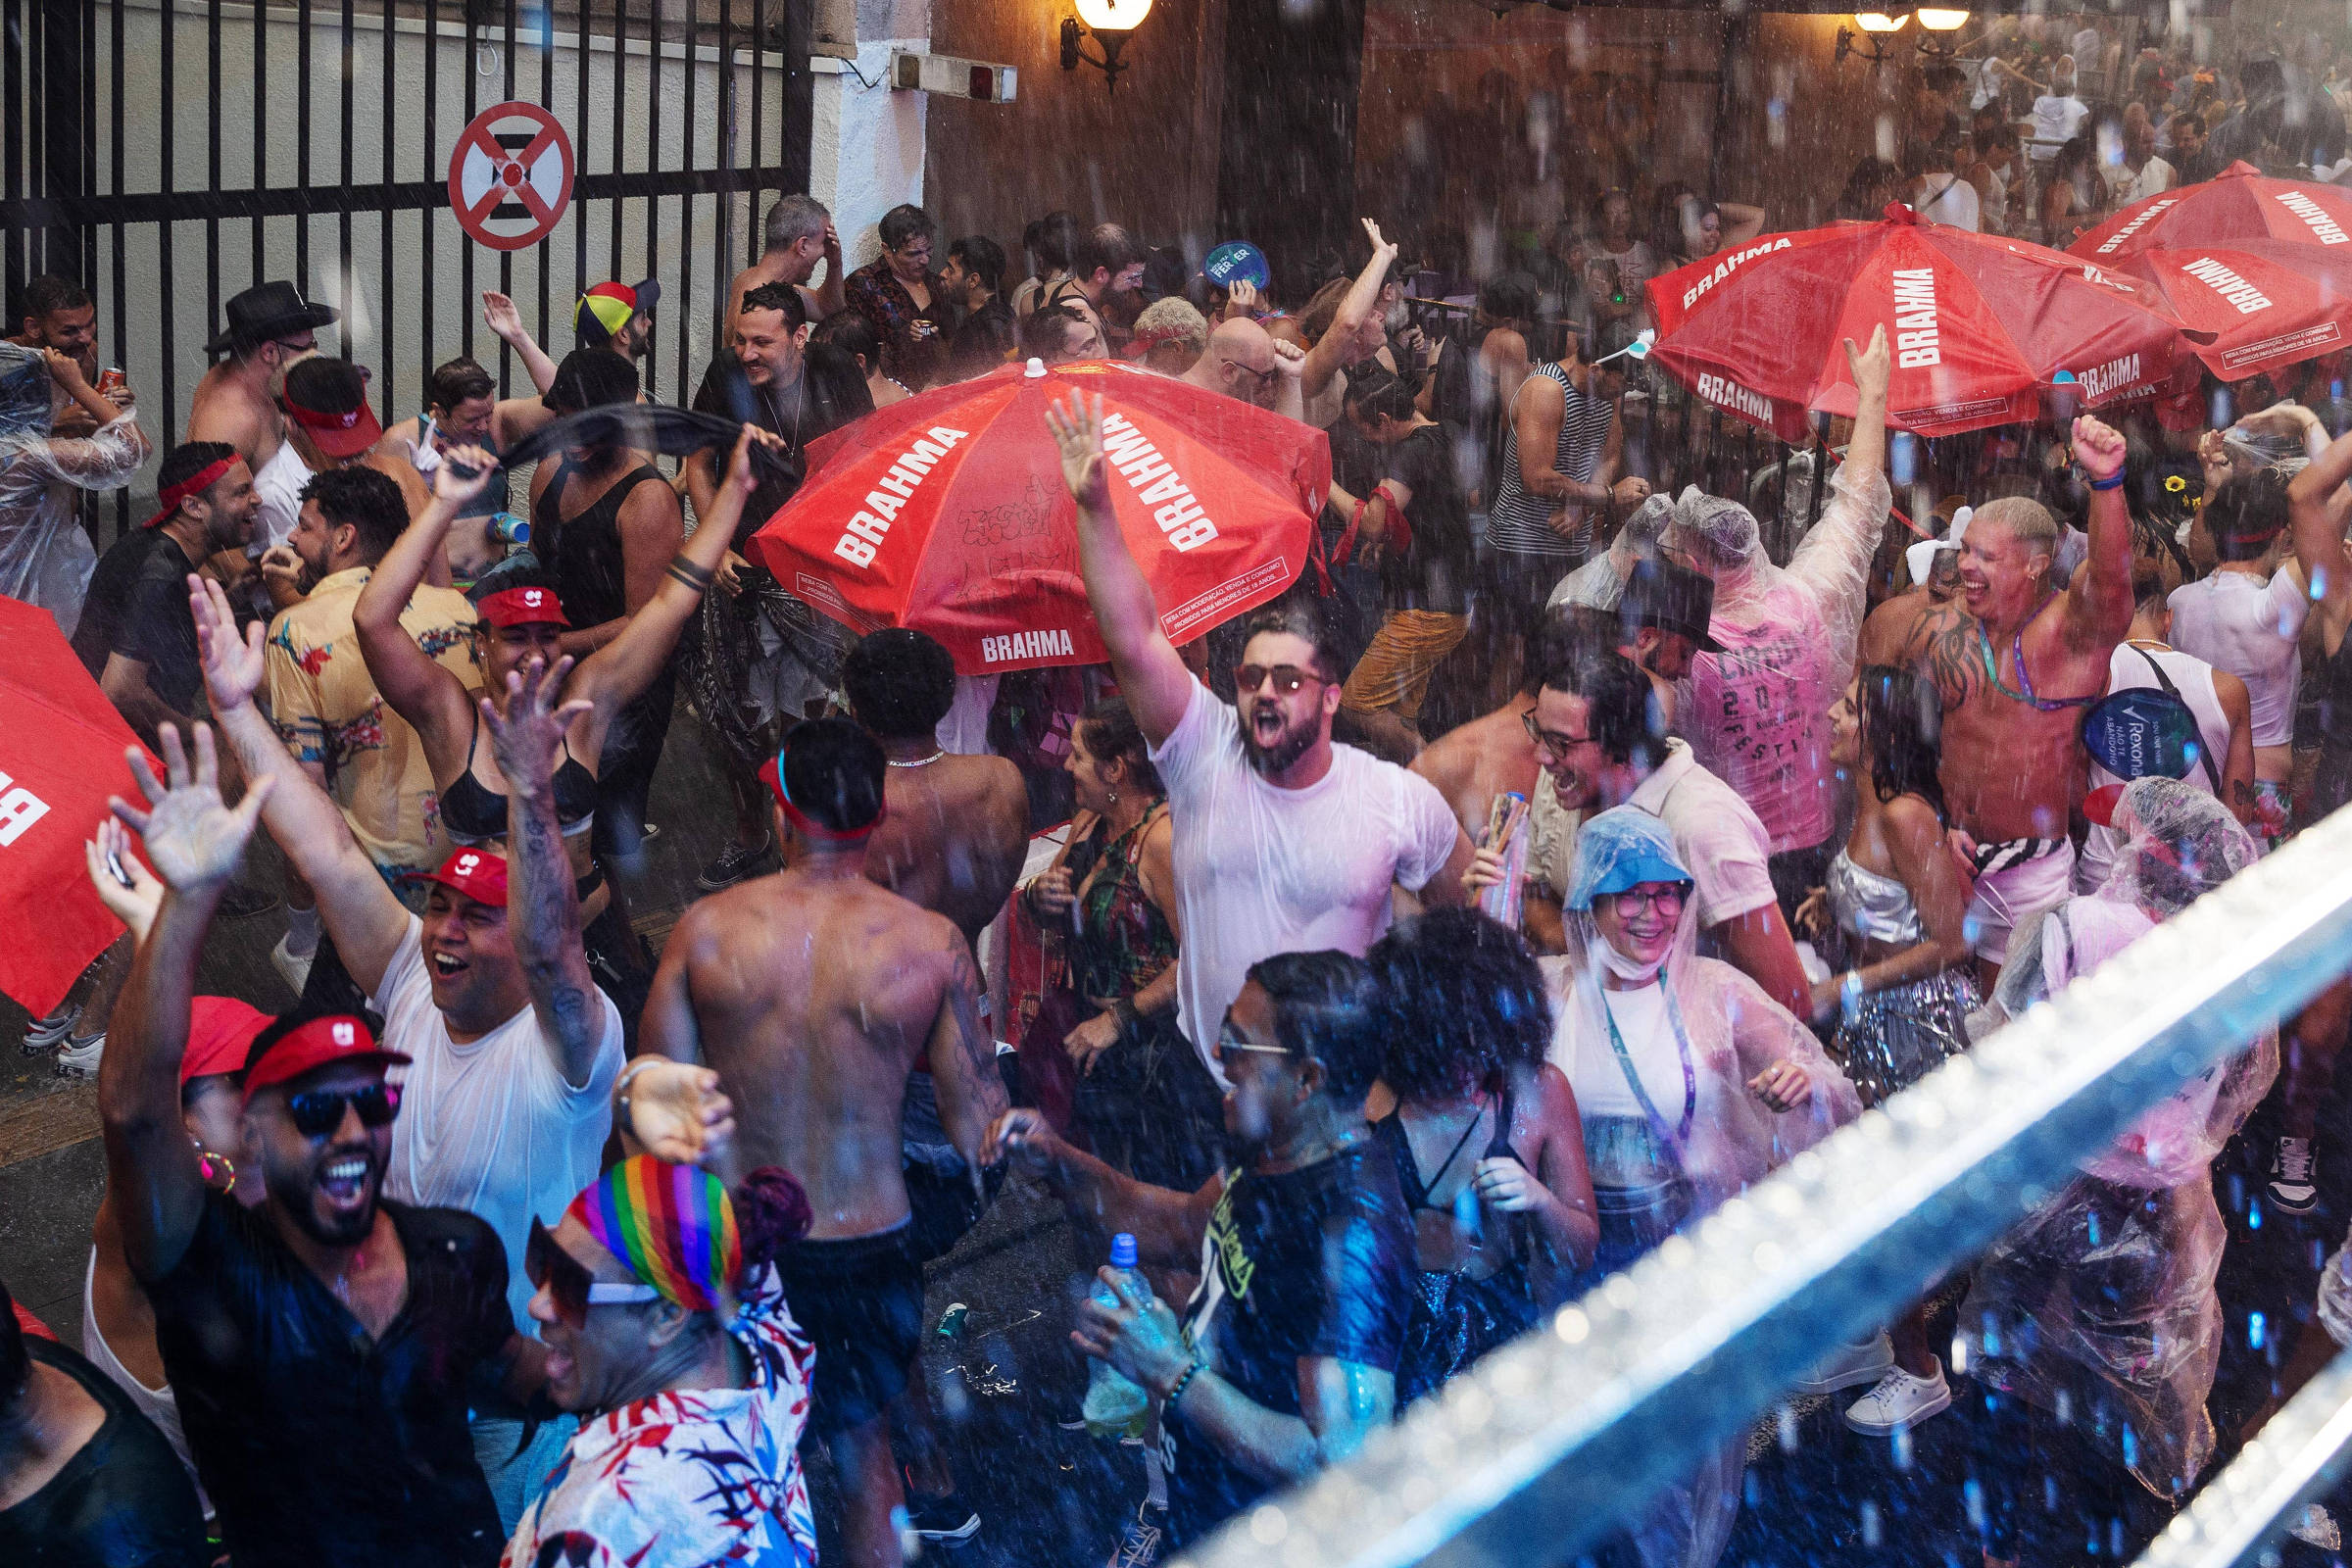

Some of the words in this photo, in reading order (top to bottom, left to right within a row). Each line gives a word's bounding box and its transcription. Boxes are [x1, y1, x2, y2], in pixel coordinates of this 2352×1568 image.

[2096, 198, 2180, 253] BRAHMA
[2275, 191, 2350, 244] BRAHMA
[1683, 237, 1791, 310] BRAHMA
[2180, 257, 2273, 314] BRAHMA
[1892, 268, 1940, 368] BRAHMA
[1697, 372, 1773, 424] BRAHMA
[834, 426, 969, 568] BRAHMA
[1102, 413, 1219, 553] BRAHMA
[1178, 606, 1192, 617] COM
[1225, 578, 1246, 593] VENDA
[1250, 561, 1281, 581] CONSUMO
[1200, 604, 1216, 615] PARA
[1214, 589, 1242, 609] MENORES
[981, 629, 1074, 662] BRAHMA
[2106, 715, 2117, 766] ABANDONO
[2129, 722, 2144, 776] Rexona
